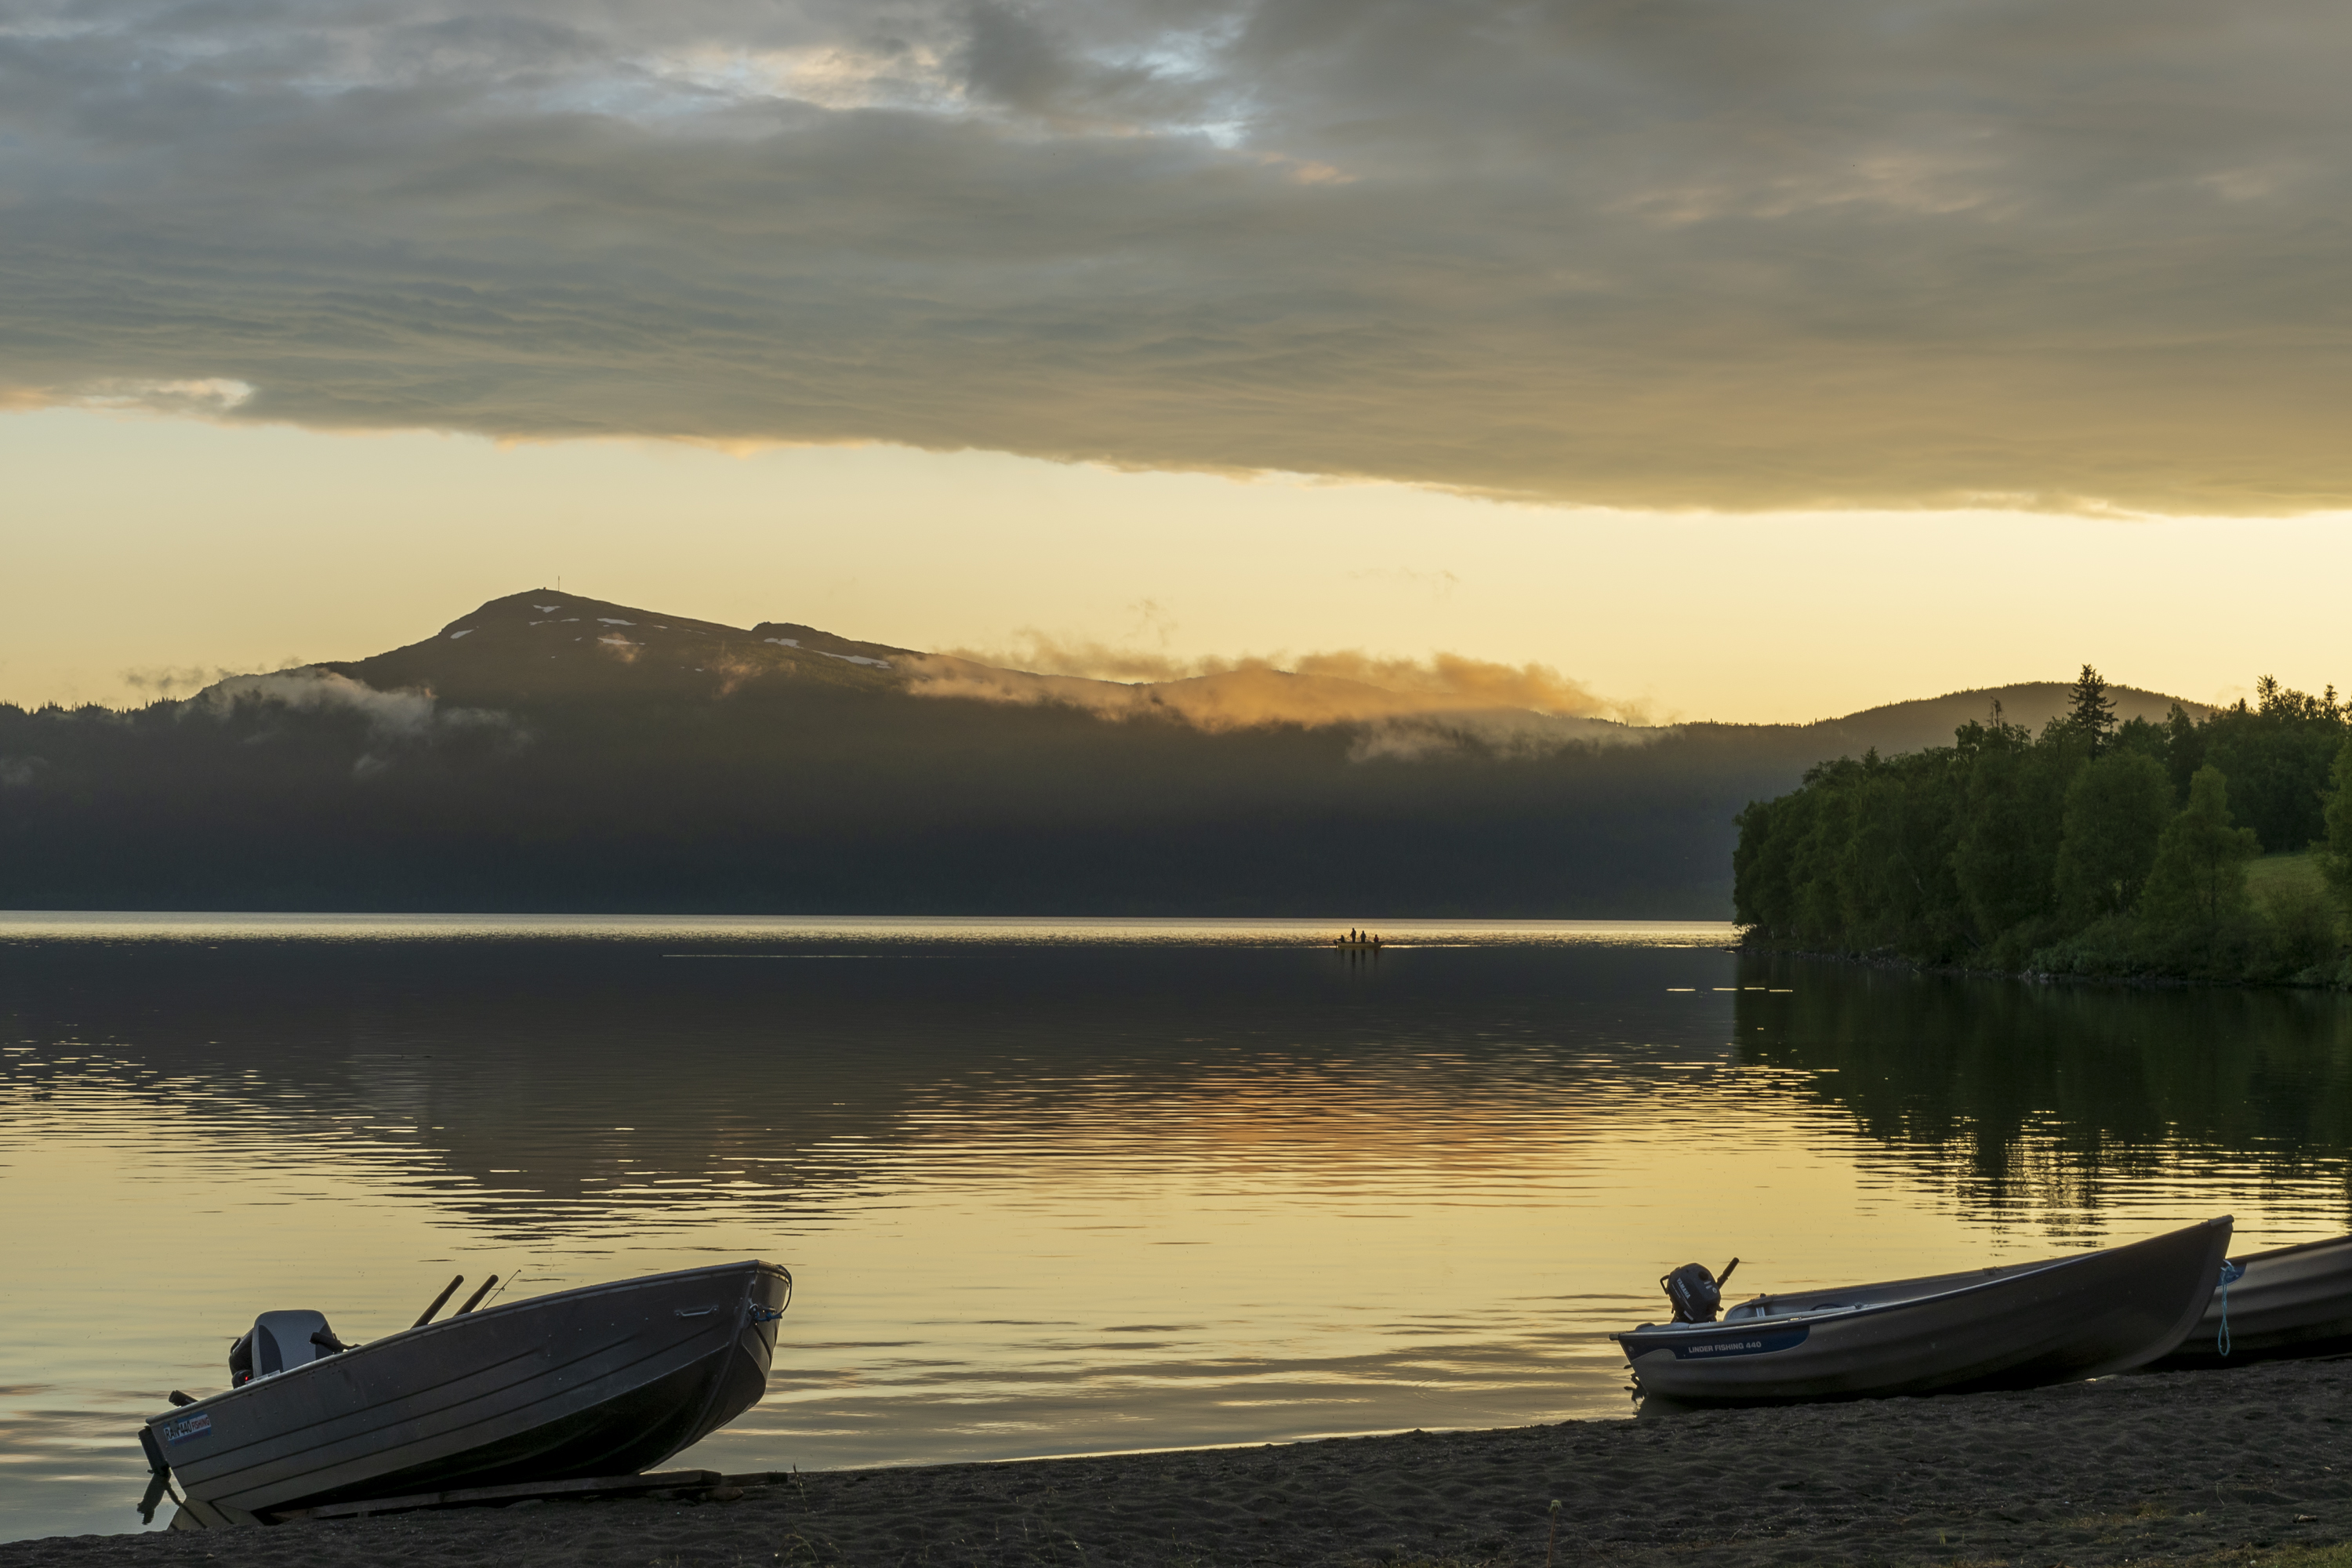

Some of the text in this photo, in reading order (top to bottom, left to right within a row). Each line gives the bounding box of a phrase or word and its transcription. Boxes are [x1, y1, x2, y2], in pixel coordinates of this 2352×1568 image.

[1677, 1277, 1691, 1299] YAMAHA
[1715, 1342, 1744, 1352] FISHING
[180, 1421, 192, 1435] 440
[191, 1417, 210, 1431] FISHING
